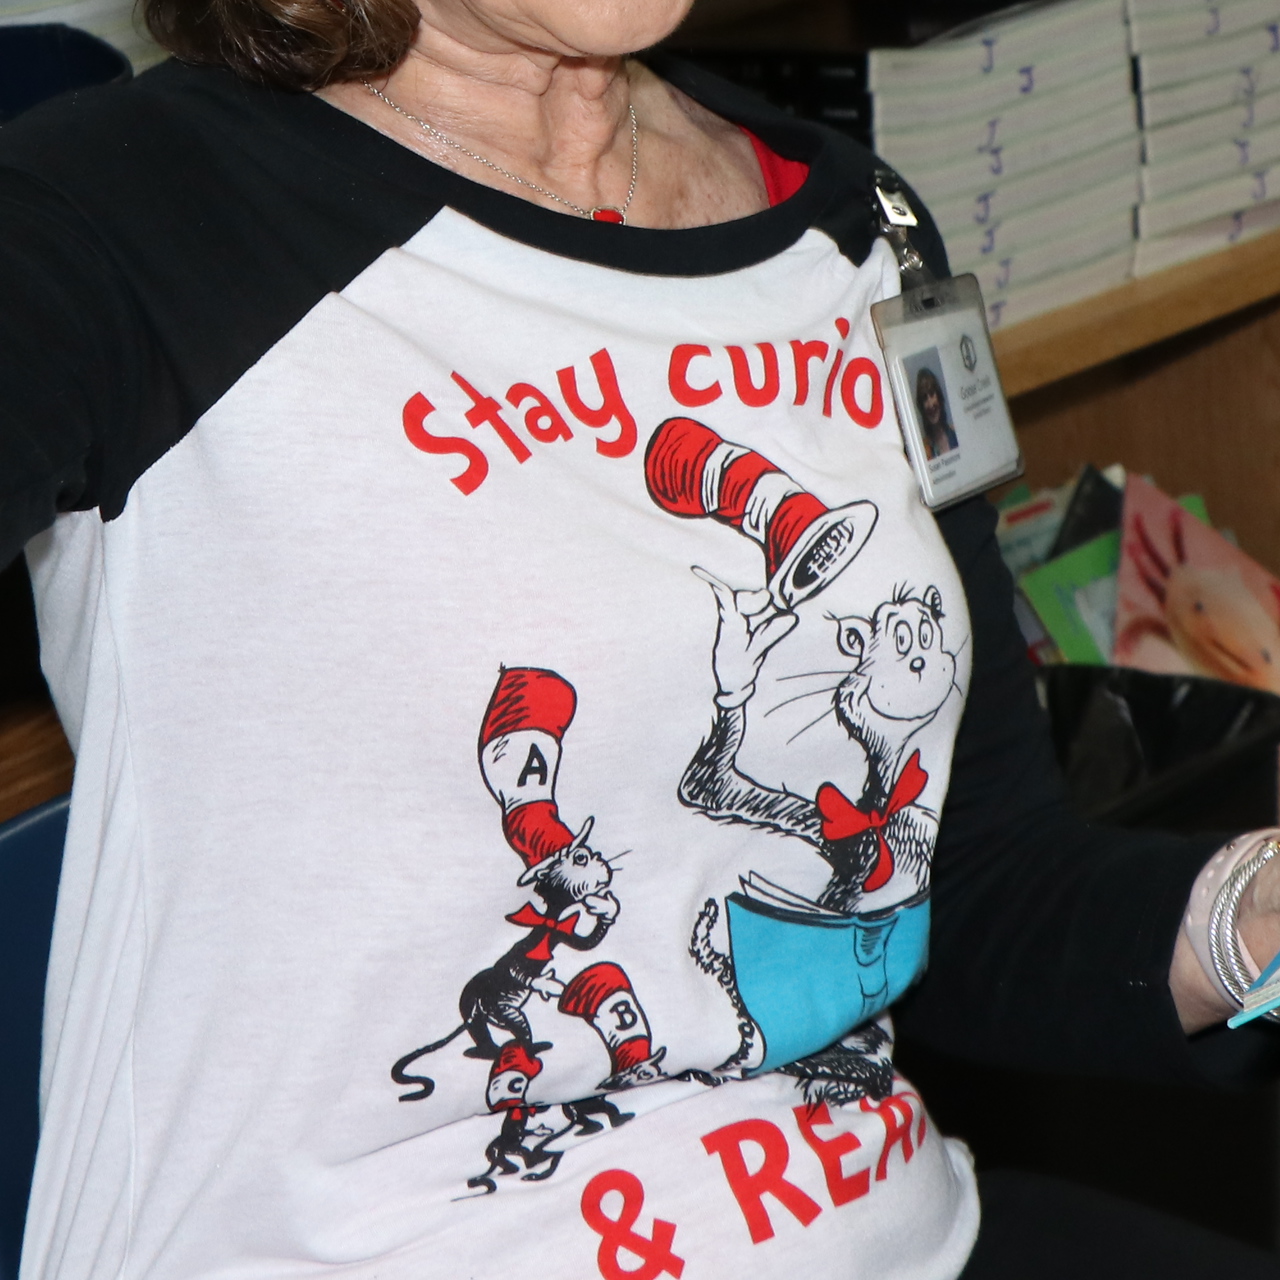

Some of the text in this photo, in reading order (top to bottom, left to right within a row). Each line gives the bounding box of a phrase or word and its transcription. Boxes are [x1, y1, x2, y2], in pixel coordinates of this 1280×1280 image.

[402, 316, 885, 497] Stay curio
[517, 742, 548, 788] A
[609, 999, 639, 1031] B
[507, 1076, 524, 1094] C
[580, 1077, 927, 1280] & REA
